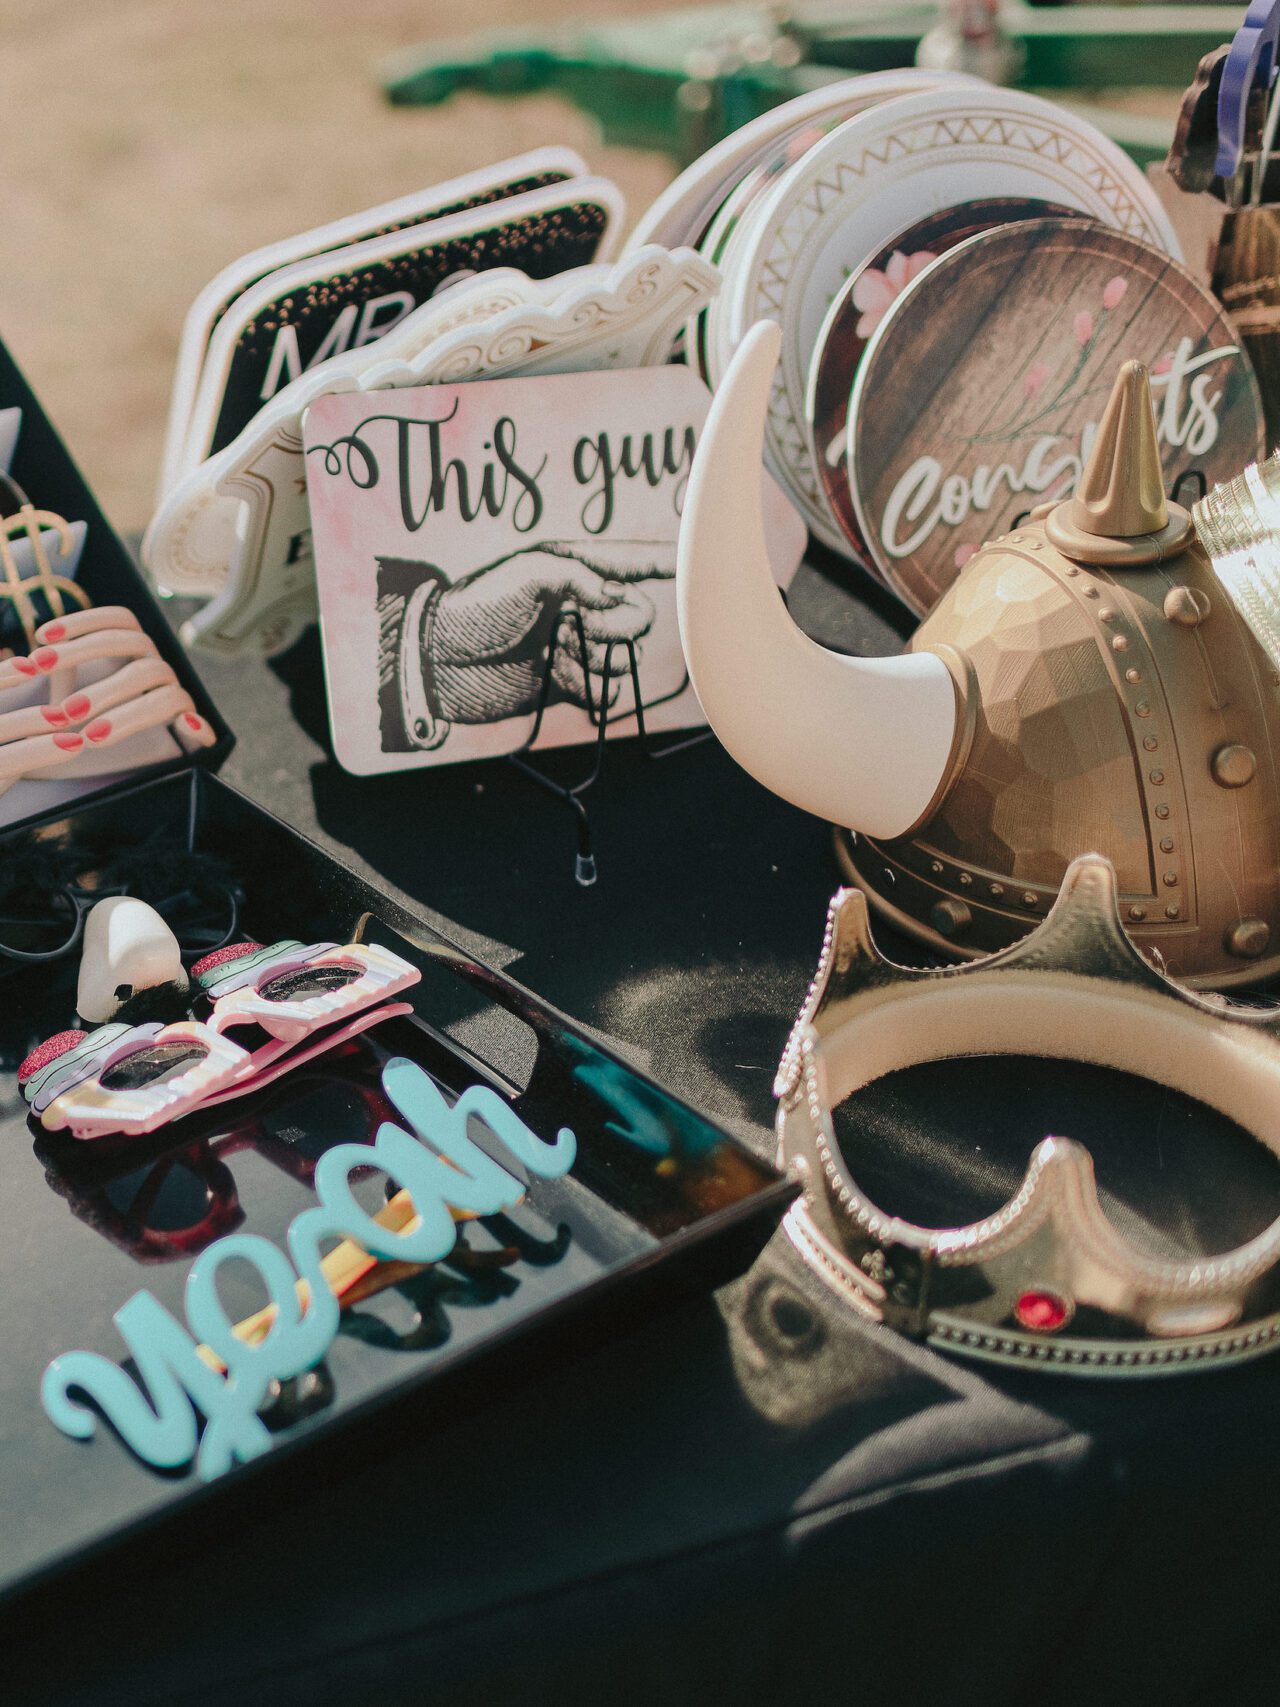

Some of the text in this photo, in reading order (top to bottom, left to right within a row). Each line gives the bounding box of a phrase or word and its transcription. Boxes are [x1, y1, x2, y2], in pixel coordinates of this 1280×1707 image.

[259, 269, 477, 400] MR
[306, 397, 547, 532] This
[881, 336, 1240, 558] Congts
